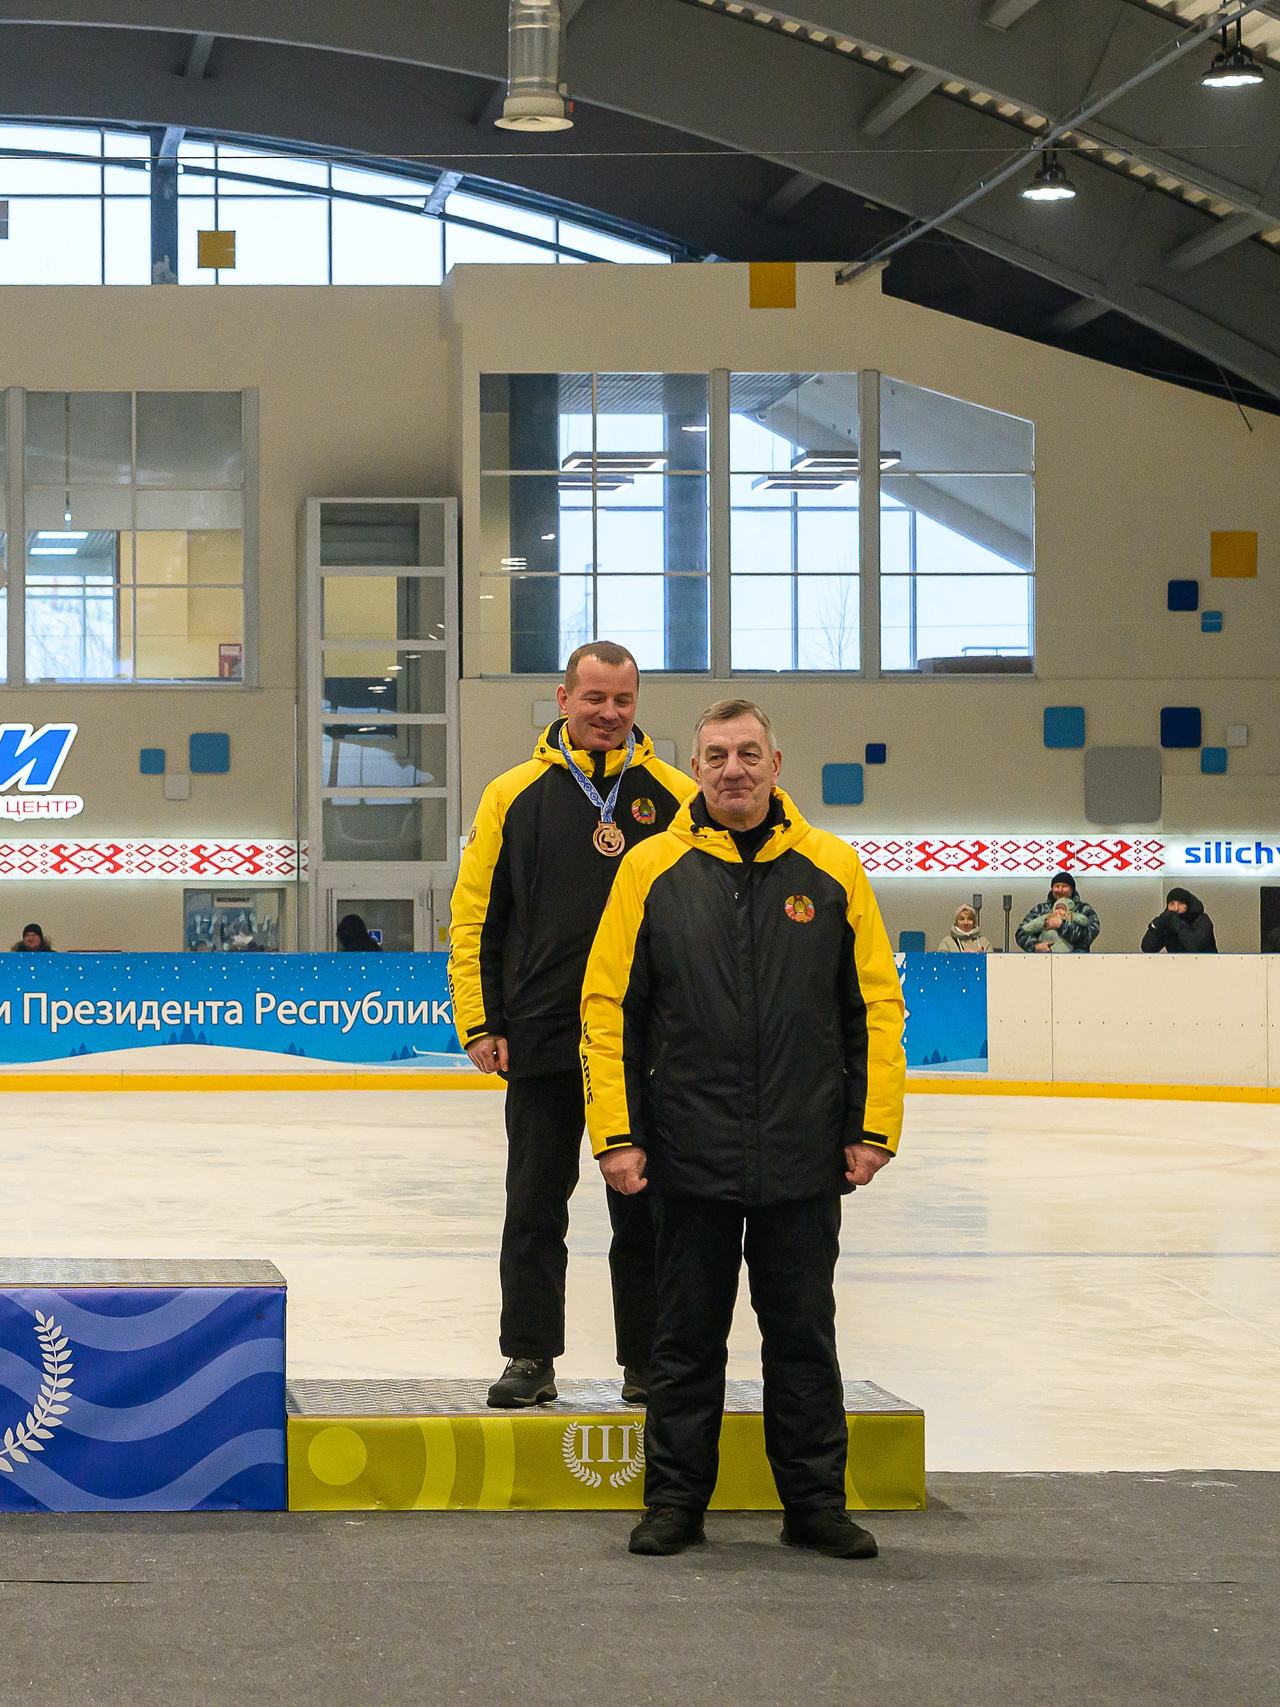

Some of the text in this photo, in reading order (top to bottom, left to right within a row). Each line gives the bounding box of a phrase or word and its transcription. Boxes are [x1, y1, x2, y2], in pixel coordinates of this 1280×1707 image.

[6, 800, 78, 816] ЦЕНТР
[1184, 841, 1280, 865] silich
[22, 991, 244, 1034] Президента
[254, 989, 456, 1035] Республик
[576, 1424, 636, 1463] III
